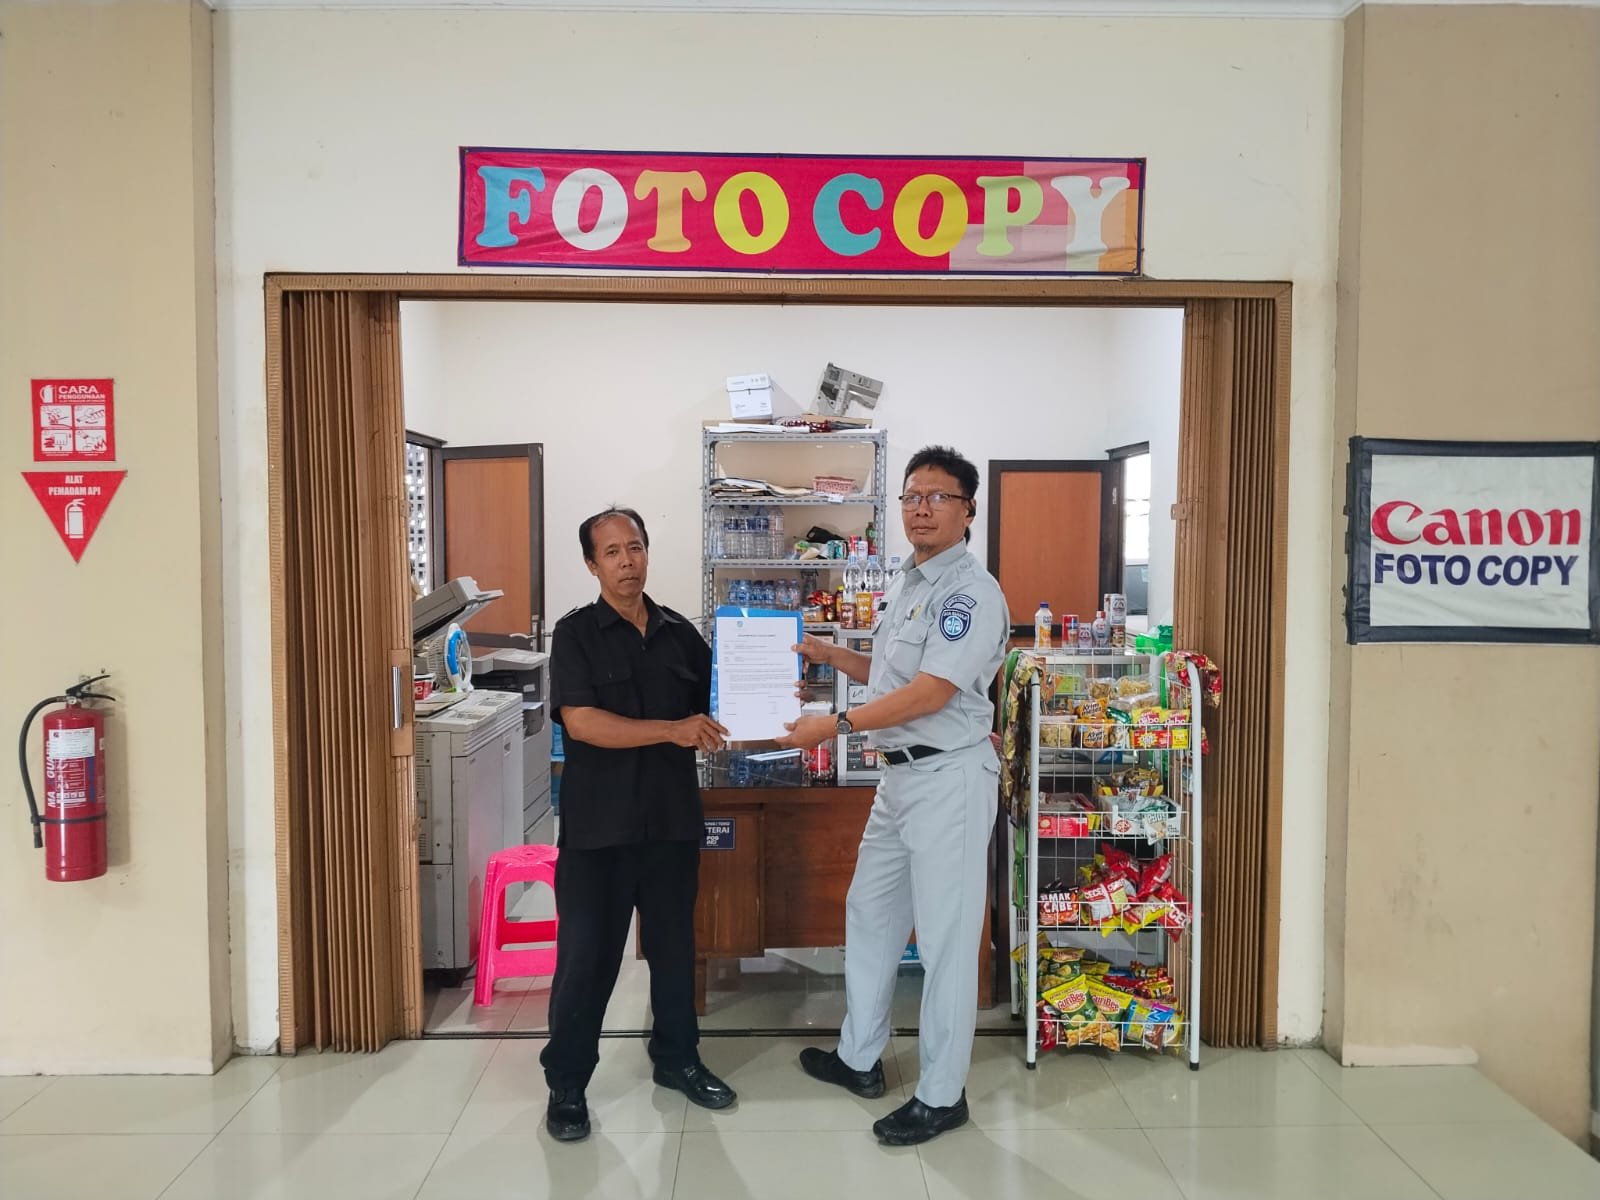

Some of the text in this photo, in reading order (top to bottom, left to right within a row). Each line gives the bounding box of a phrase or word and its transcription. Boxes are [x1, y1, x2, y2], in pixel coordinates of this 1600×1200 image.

[477, 165, 1131, 256] FOTO COPY
[58, 385, 98, 394] CARA
[65, 475, 84, 484] ALAT
[48, 487, 101, 496] PEMADAM API
[1371, 500, 1582, 546] Canon
[1374, 553, 1580, 586] FOTO COPY
[705, 826, 730, 834] TERAI
